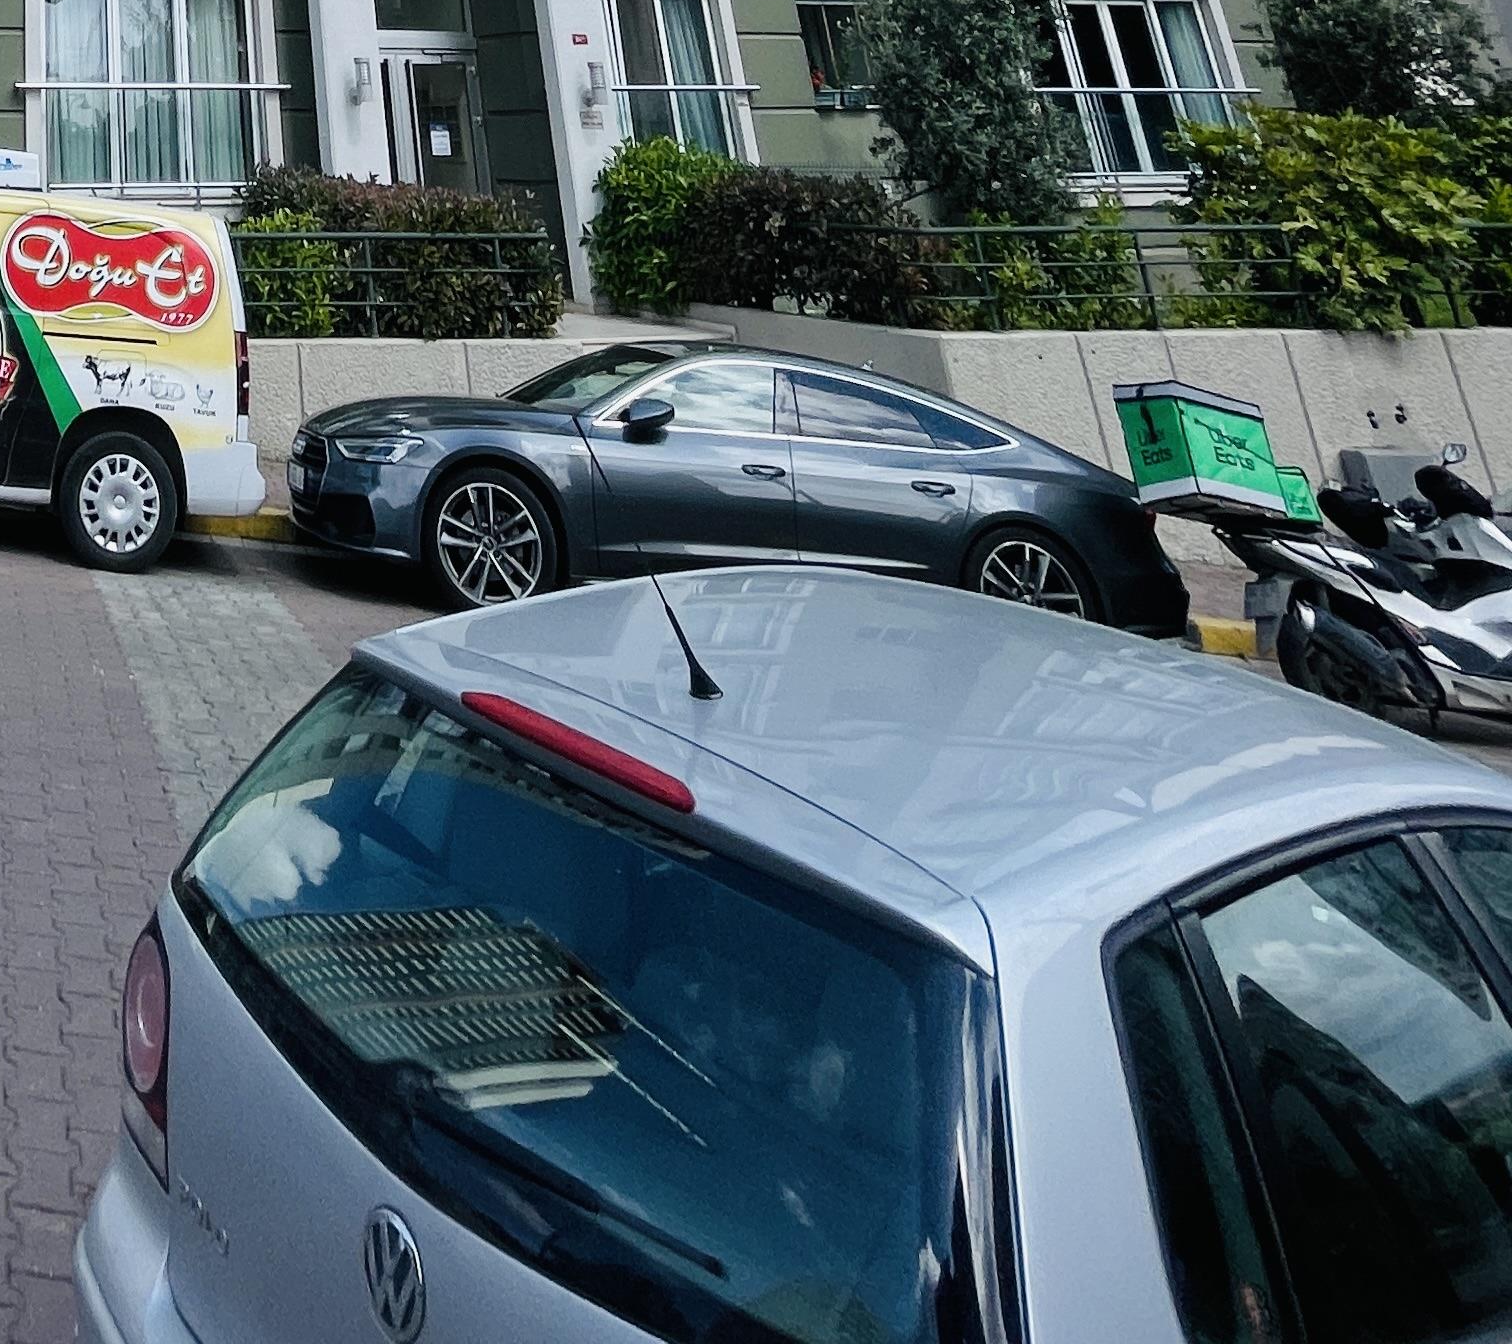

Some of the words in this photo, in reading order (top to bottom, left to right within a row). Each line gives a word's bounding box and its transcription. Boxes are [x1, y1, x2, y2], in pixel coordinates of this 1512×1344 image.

[10, 226, 137, 299] Doğu
[137, 244, 206, 308] Et
[160, 312, 194, 325] 1977
[1141, 447, 1173, 465] Eats
[1213, 445, 1255, 471] Eats
